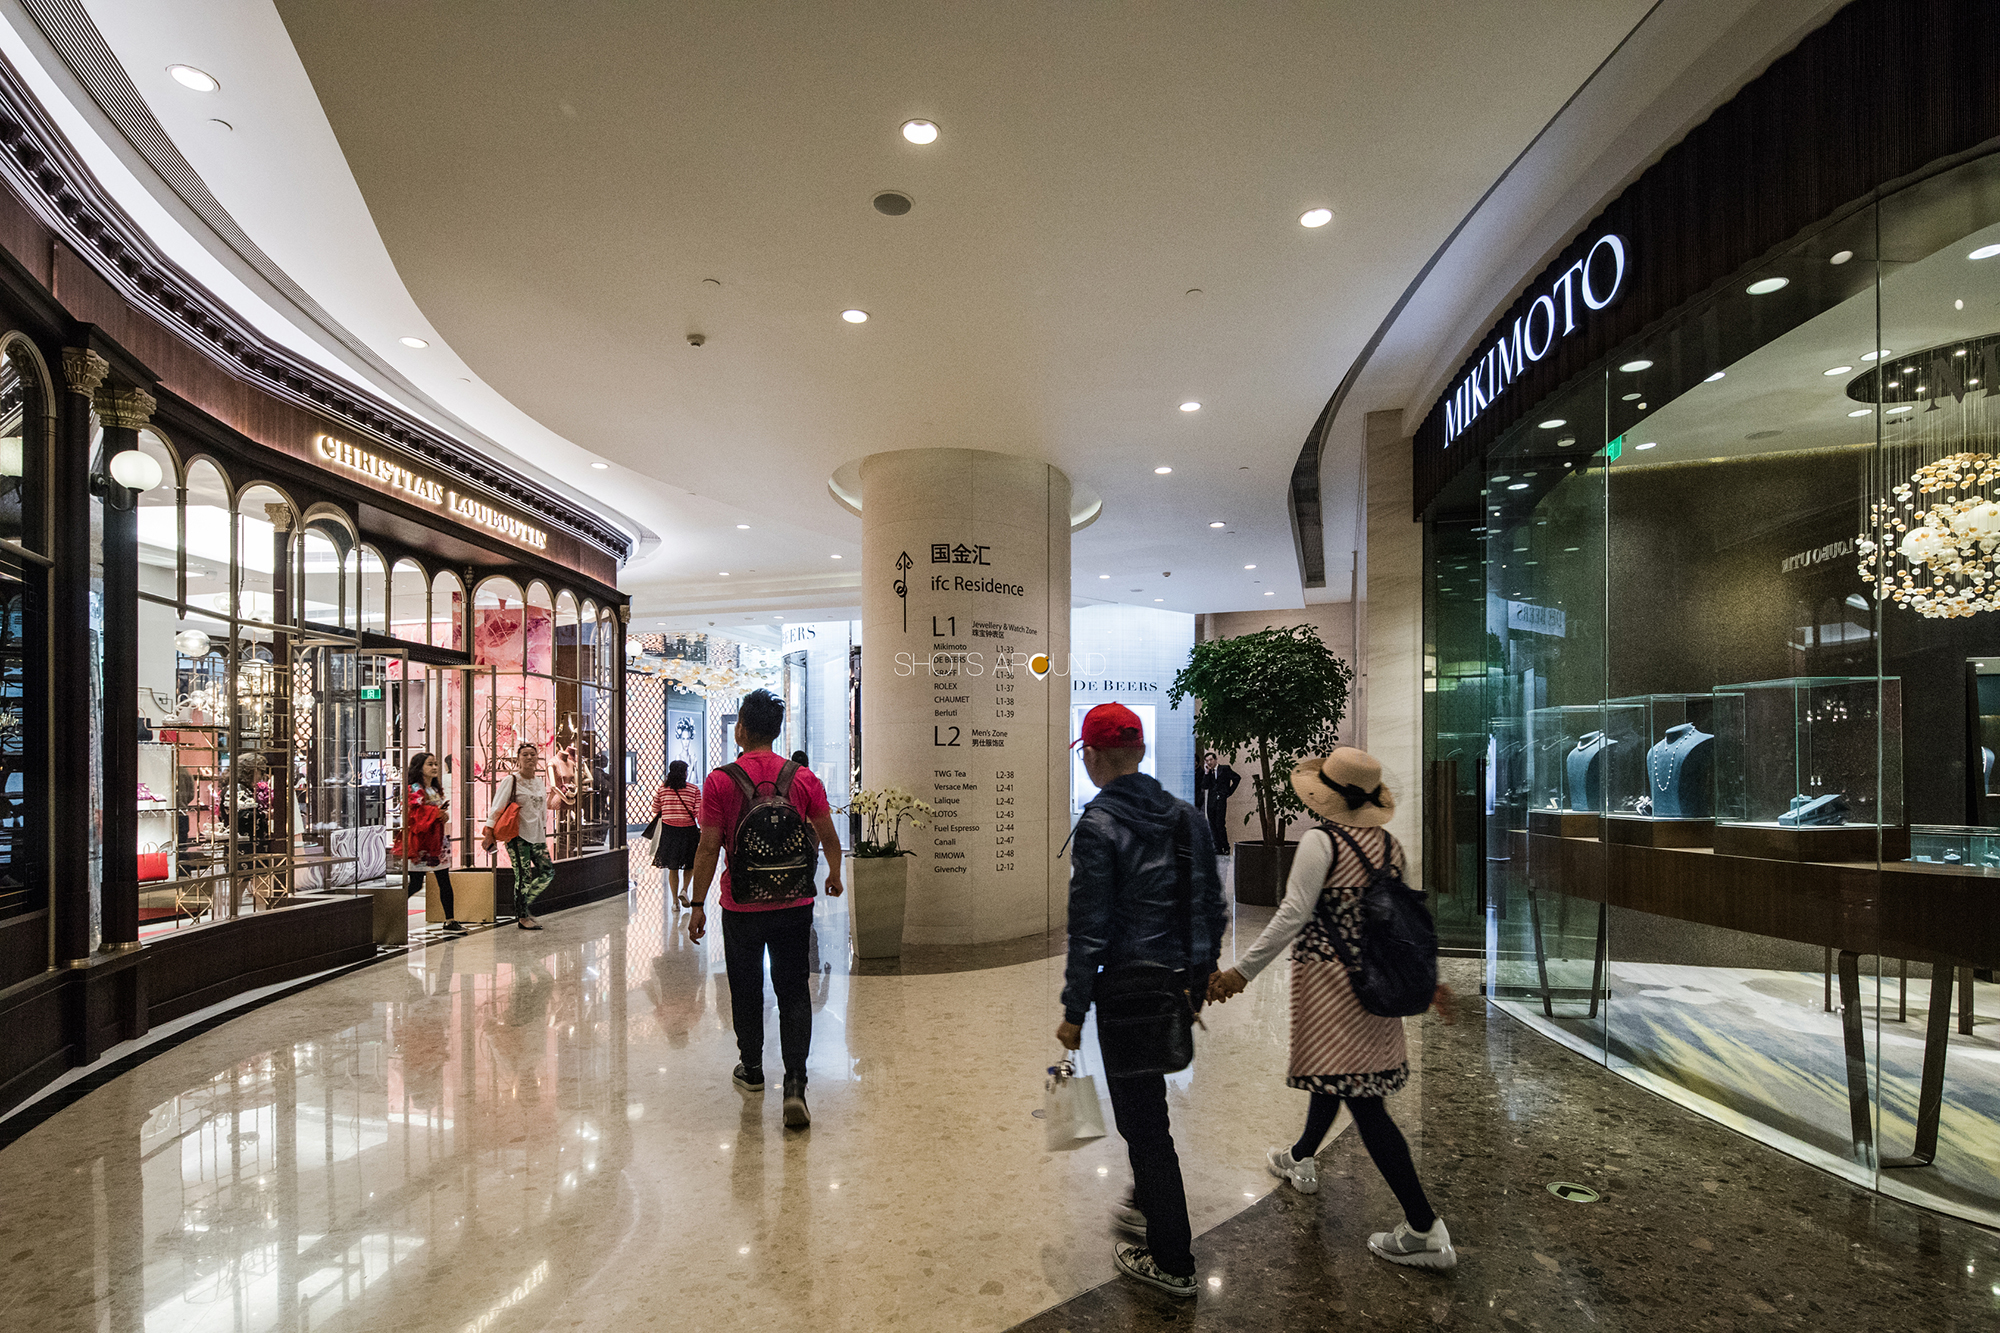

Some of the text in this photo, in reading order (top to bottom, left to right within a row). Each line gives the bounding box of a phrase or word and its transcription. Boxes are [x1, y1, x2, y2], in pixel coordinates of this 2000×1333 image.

[1443, 234, 1625, 449] MIKIMOTO
[315, 434, 547, 549] CHRISTIAN LOUBOUTIN
[931, 544, 991, 565] 国金汇
[931, 576, 1024, 596] ifc Residence
[933, 616, 955, 637] L1
[972, 621, 1003, 630] Jewellery
[1008, 624, 1025, 633] Watch
[1026, 626, 1038, 635] Zone
[996, 645, 1014, 653] L1-33
[996, 684, 1014, 692] L1-37
[1074, 680, 1157, 692] DE BEERS
[996, 697, 1014, 705] L1-38
[934, 709, 1014, 718] Berluti L1-39
[934, 725, 960, 746] L2
[972, 729, 991, 737] Men's
[996, 771, 1014, 779] L2-38
[996, 784, 1014, 792] L2-41
[934, 797, 960, 806] Lalique
[951, 825, 979, 833] Espresso
[996, 824, 1014, 832] L2-44
[996, 850, 1014, 858] L2-48
[934, 863, 1014, 874] Givenchy L2-12
